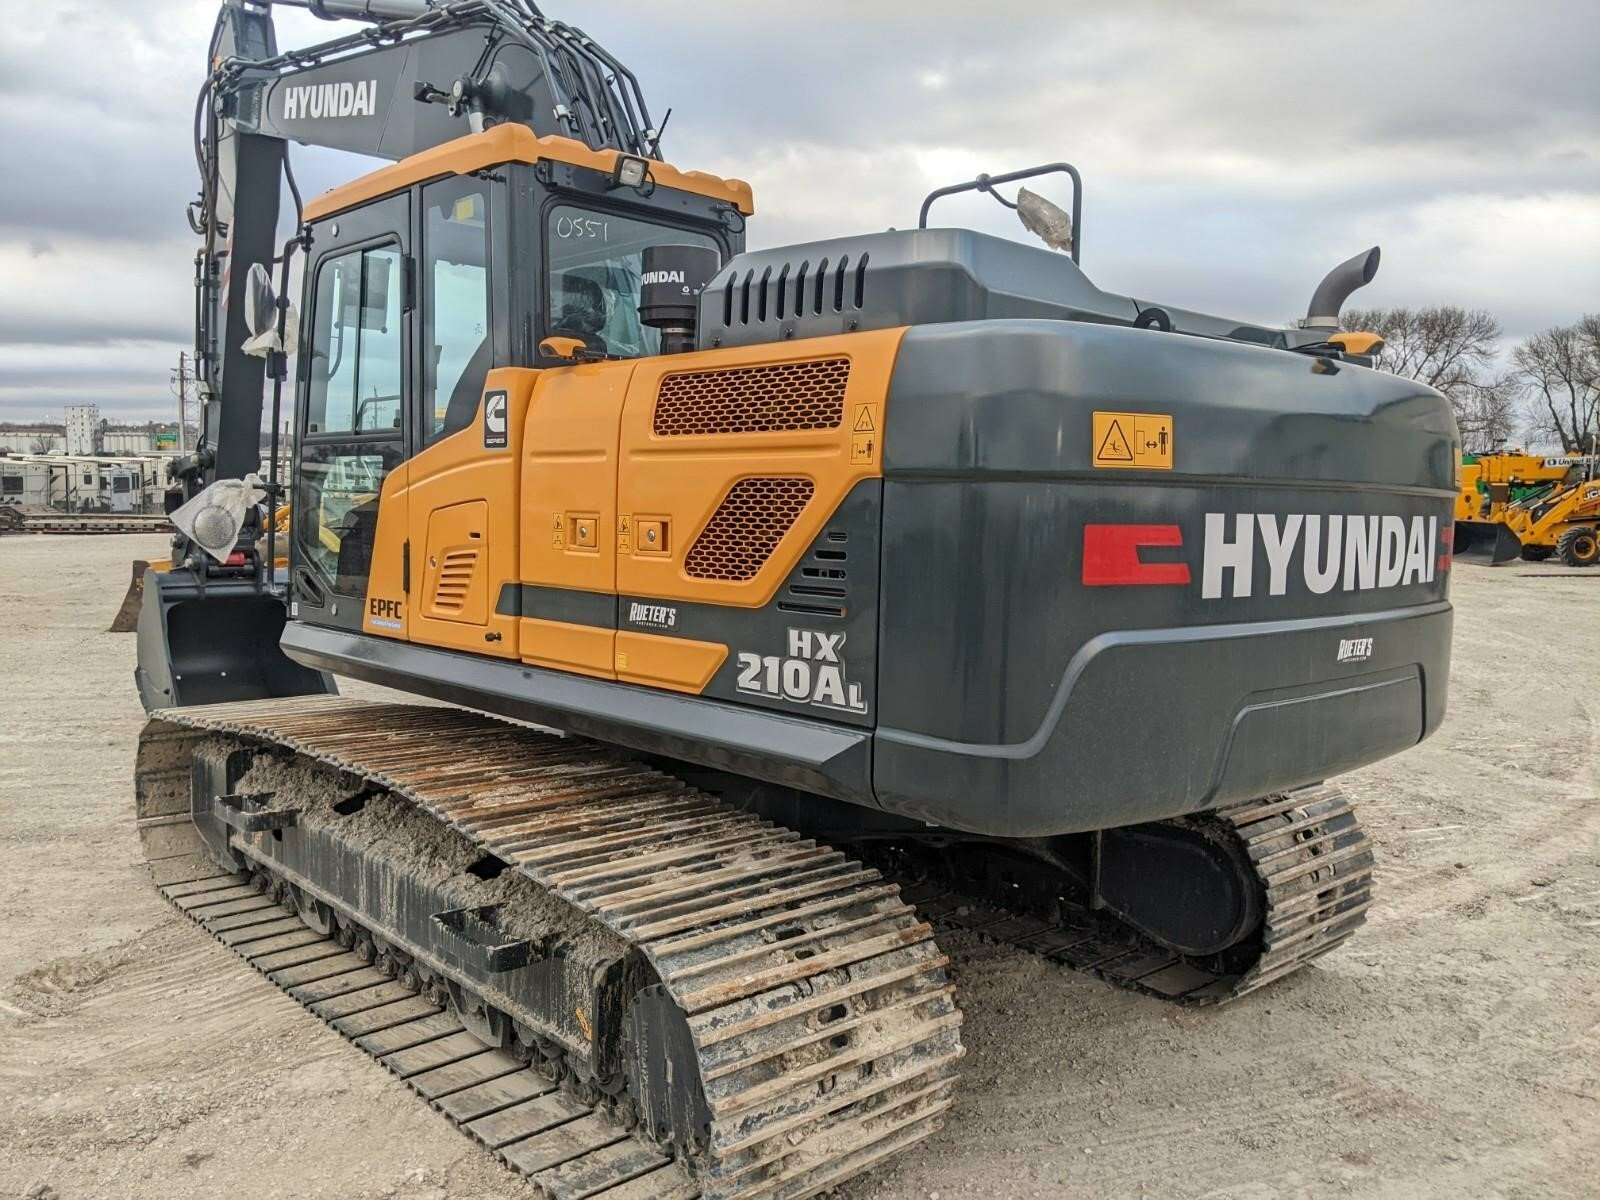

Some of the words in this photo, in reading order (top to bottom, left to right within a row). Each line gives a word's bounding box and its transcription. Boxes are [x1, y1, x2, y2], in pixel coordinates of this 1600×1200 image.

[284, 80, 377, 119] HYUNDAI
[557, 216, 608, 242] 0551
[1583, 488, 1600, 500] JC
[1202, 513, 1437, 599] HYUNDAI
[370, 598, 402, 619] EPFC
[629, 602, 676, 626] RUETER'S
[789, 629, 841, 662] HX
[1337, 638, 1373, 661] RUETER'S
